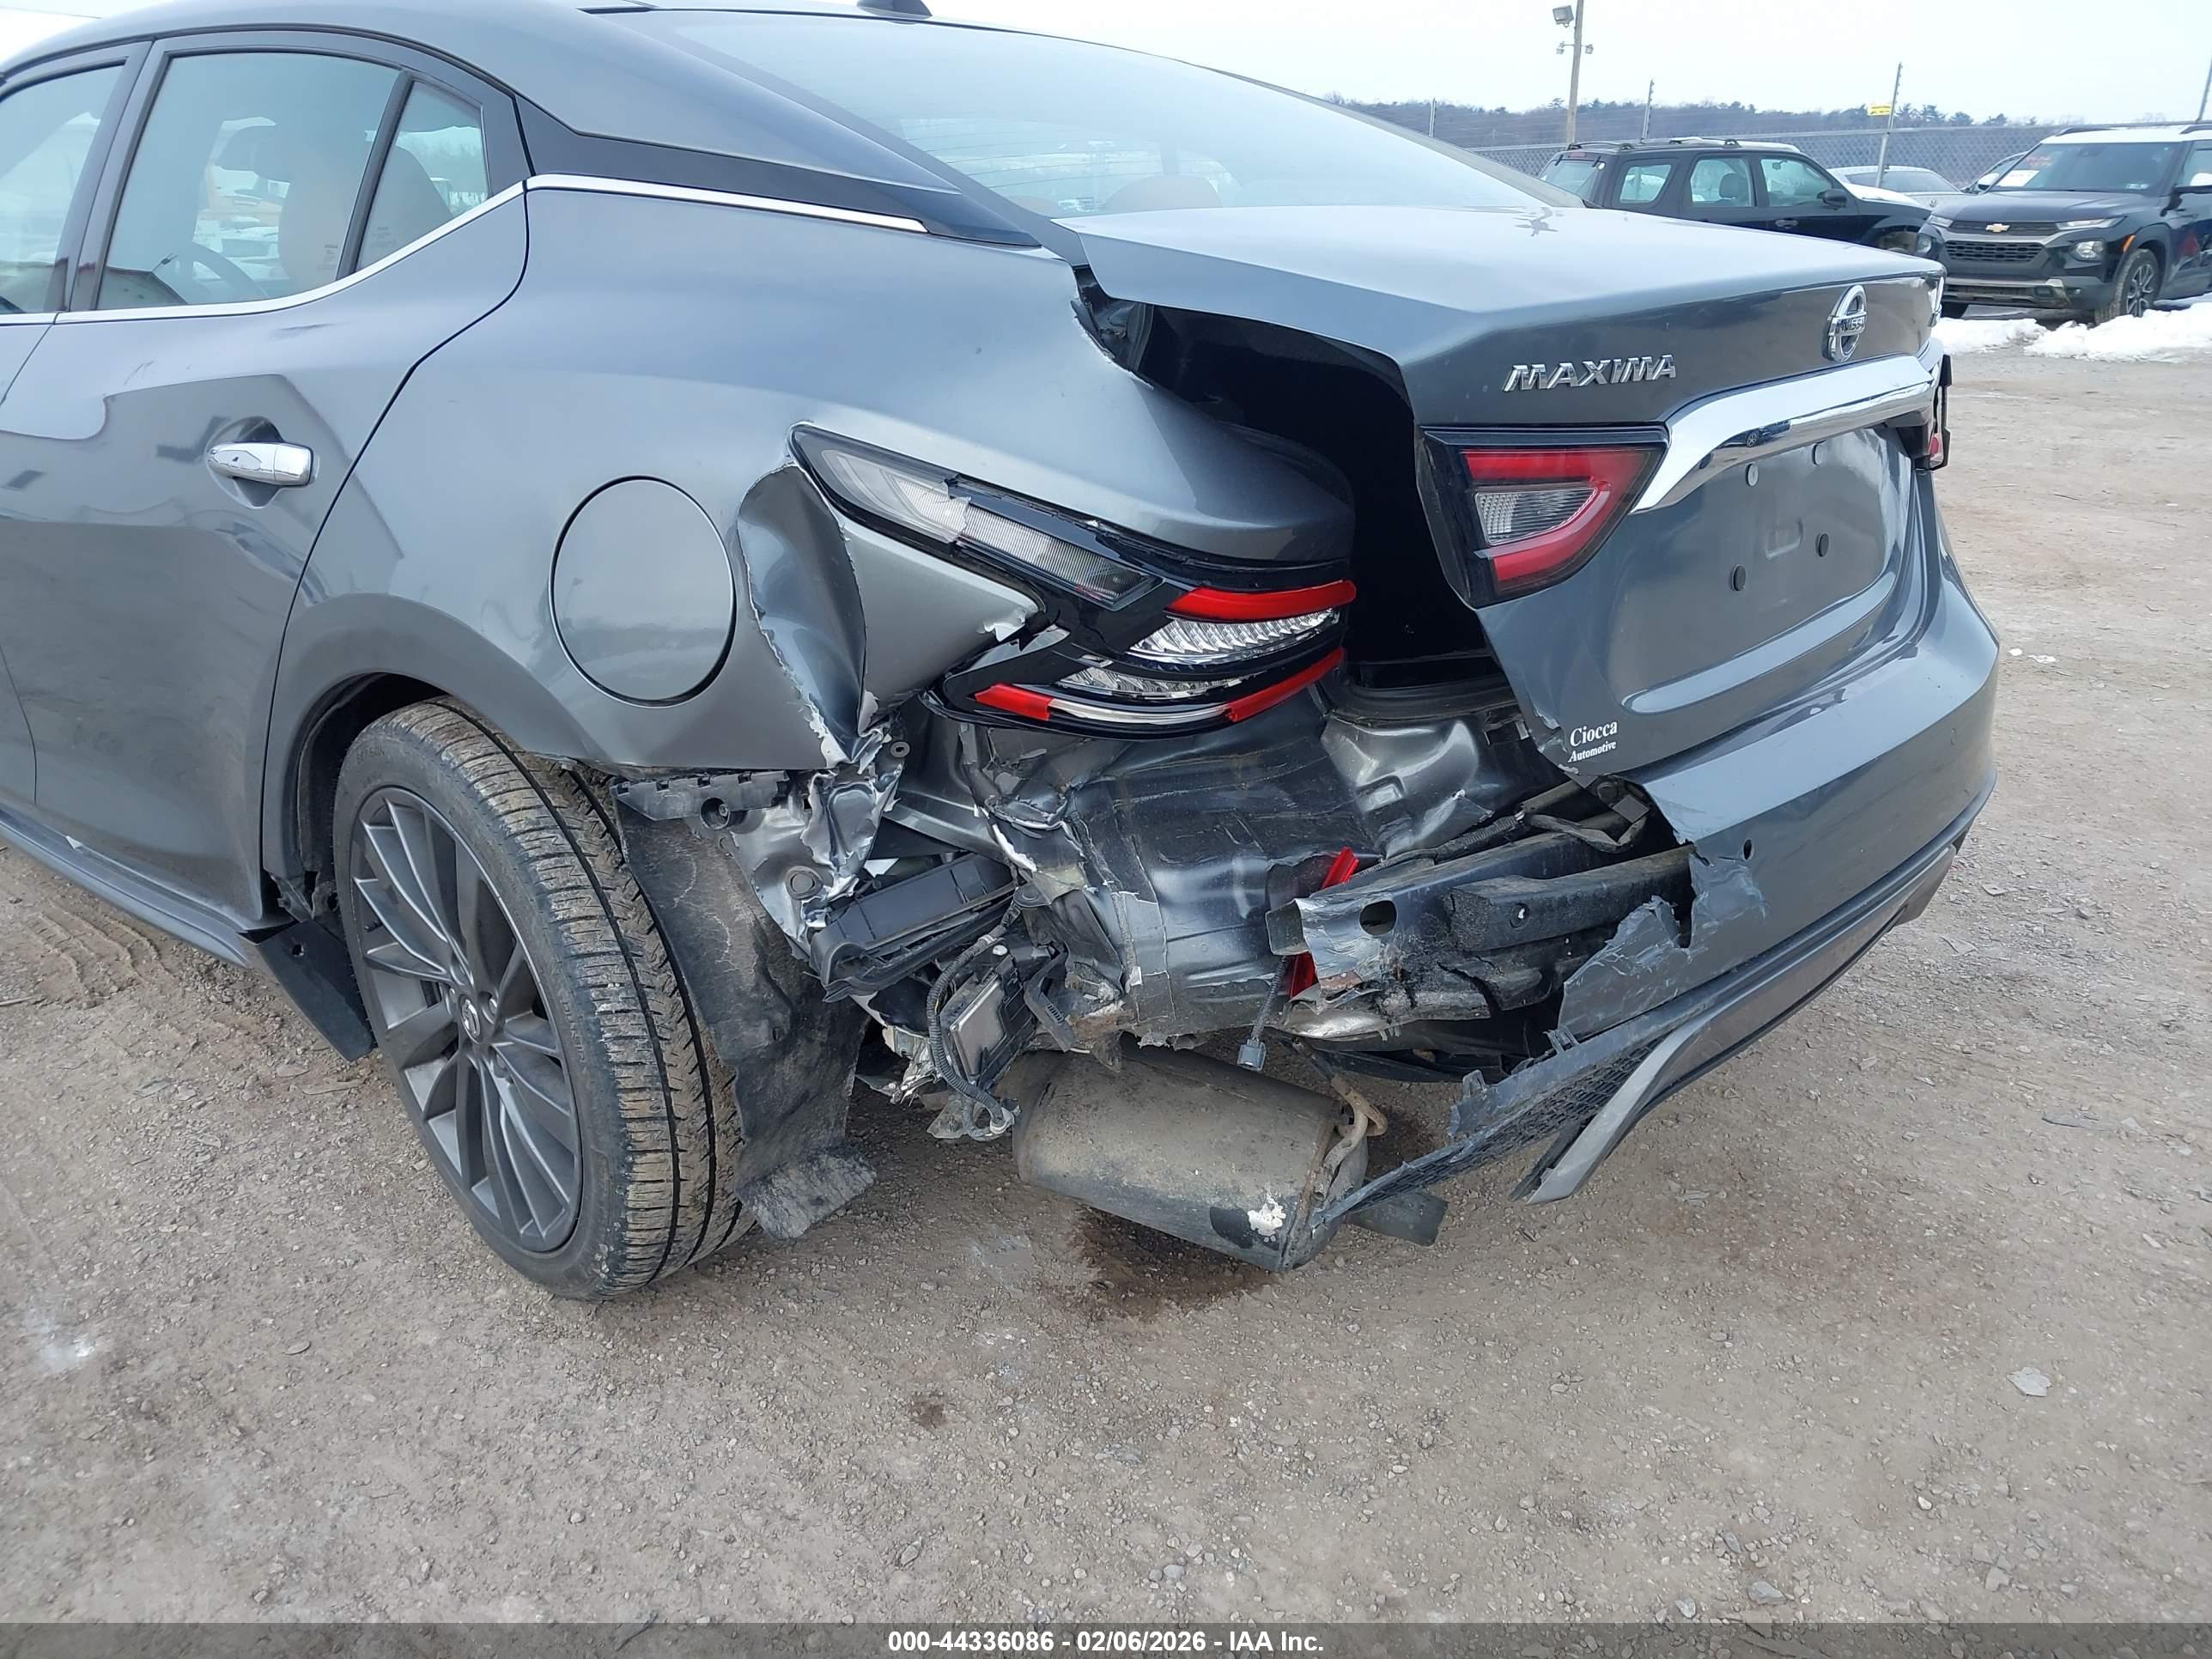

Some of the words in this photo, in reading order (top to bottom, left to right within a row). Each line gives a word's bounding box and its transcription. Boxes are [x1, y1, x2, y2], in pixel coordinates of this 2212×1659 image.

[1503, 354, 1677, 392] MAXIMA
[1571, 721, 1618, 746] Ciocca
[1568, 741, 1616, 763] Automotive
